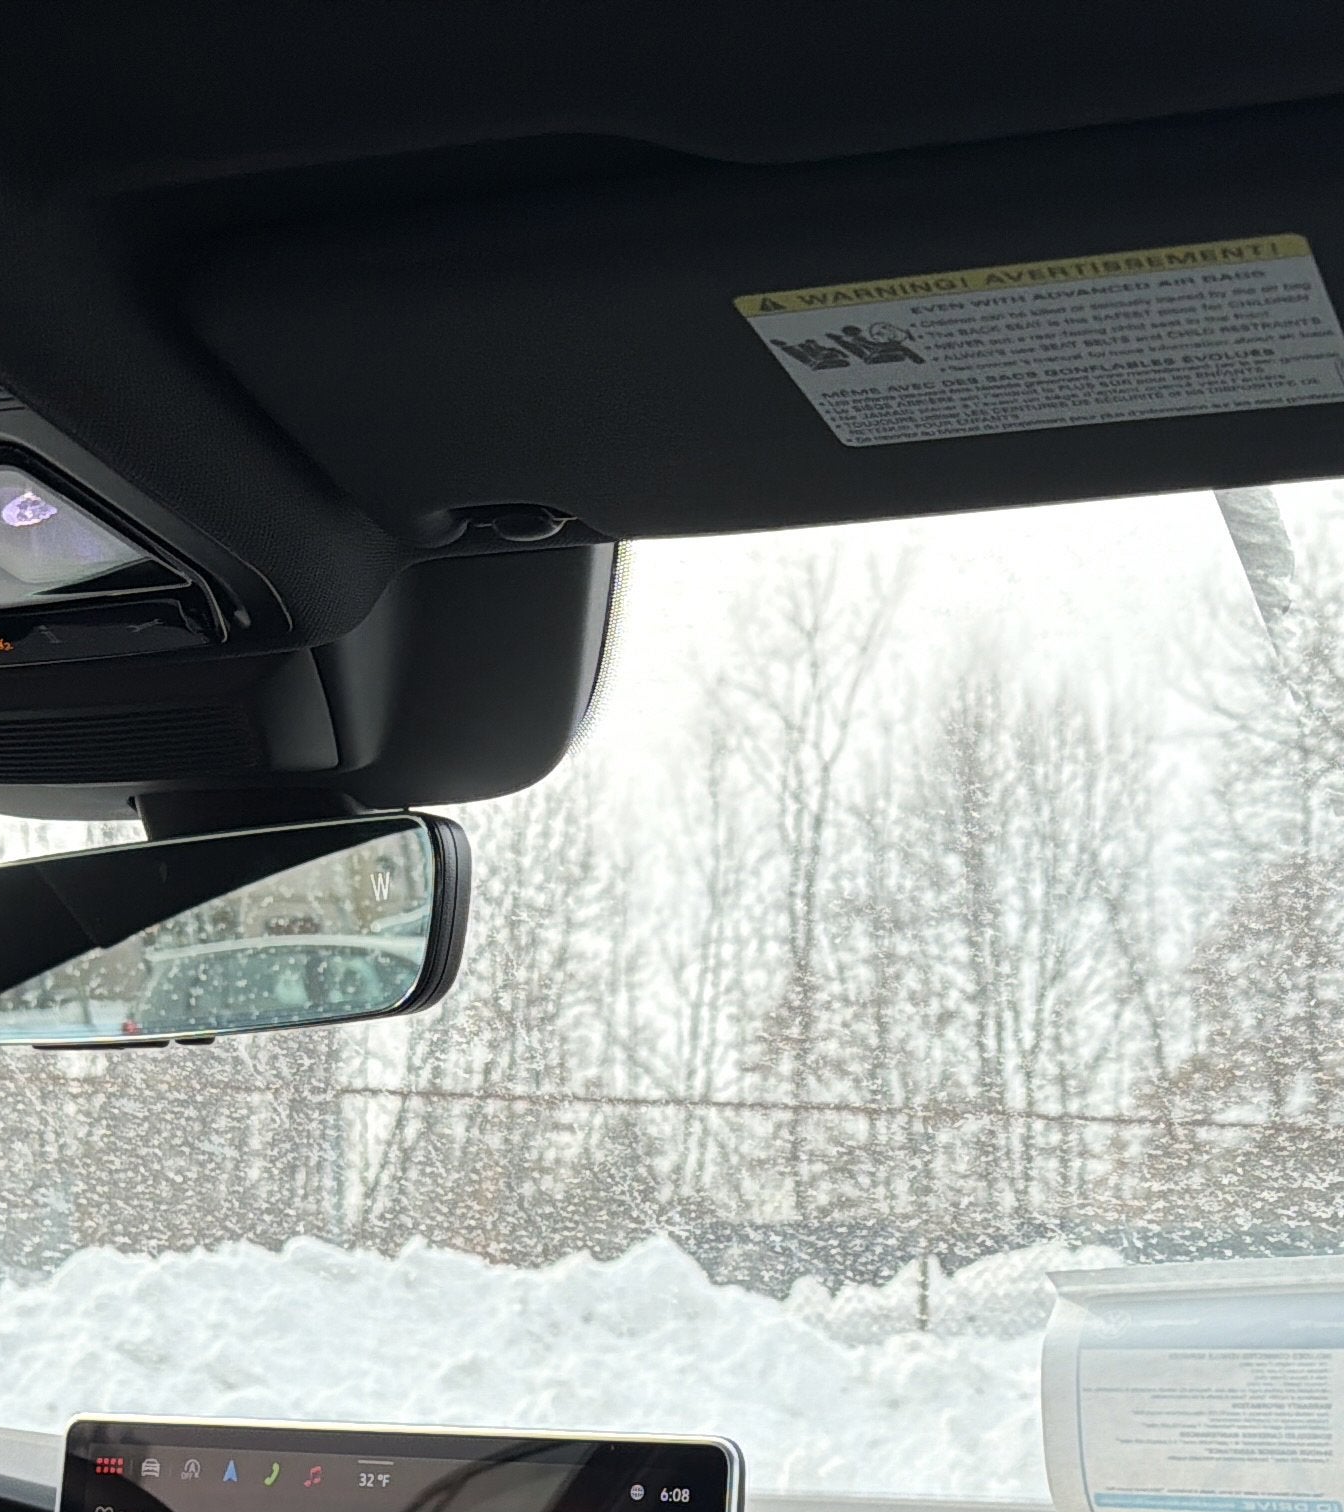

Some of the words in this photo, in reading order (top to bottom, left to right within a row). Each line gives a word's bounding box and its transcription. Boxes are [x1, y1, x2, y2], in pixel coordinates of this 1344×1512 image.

[796, 277, 968, 305] WARNING!
[986, 242, 1277, 285] AVERTISSEMENT!
[911, 302, 965, 315] EVEN
[971, 295, 1027, 308] WITH
[1033, 282, 1150, 301] ADVANCED
[1158, 276, 1196, 288] AIR
[370, 871, 390, 902] W
[358, 1472, 375, 1488] 32
[377, 1473, 391, 1488] °F
[660, 1487, 691, 1503] 6:08
